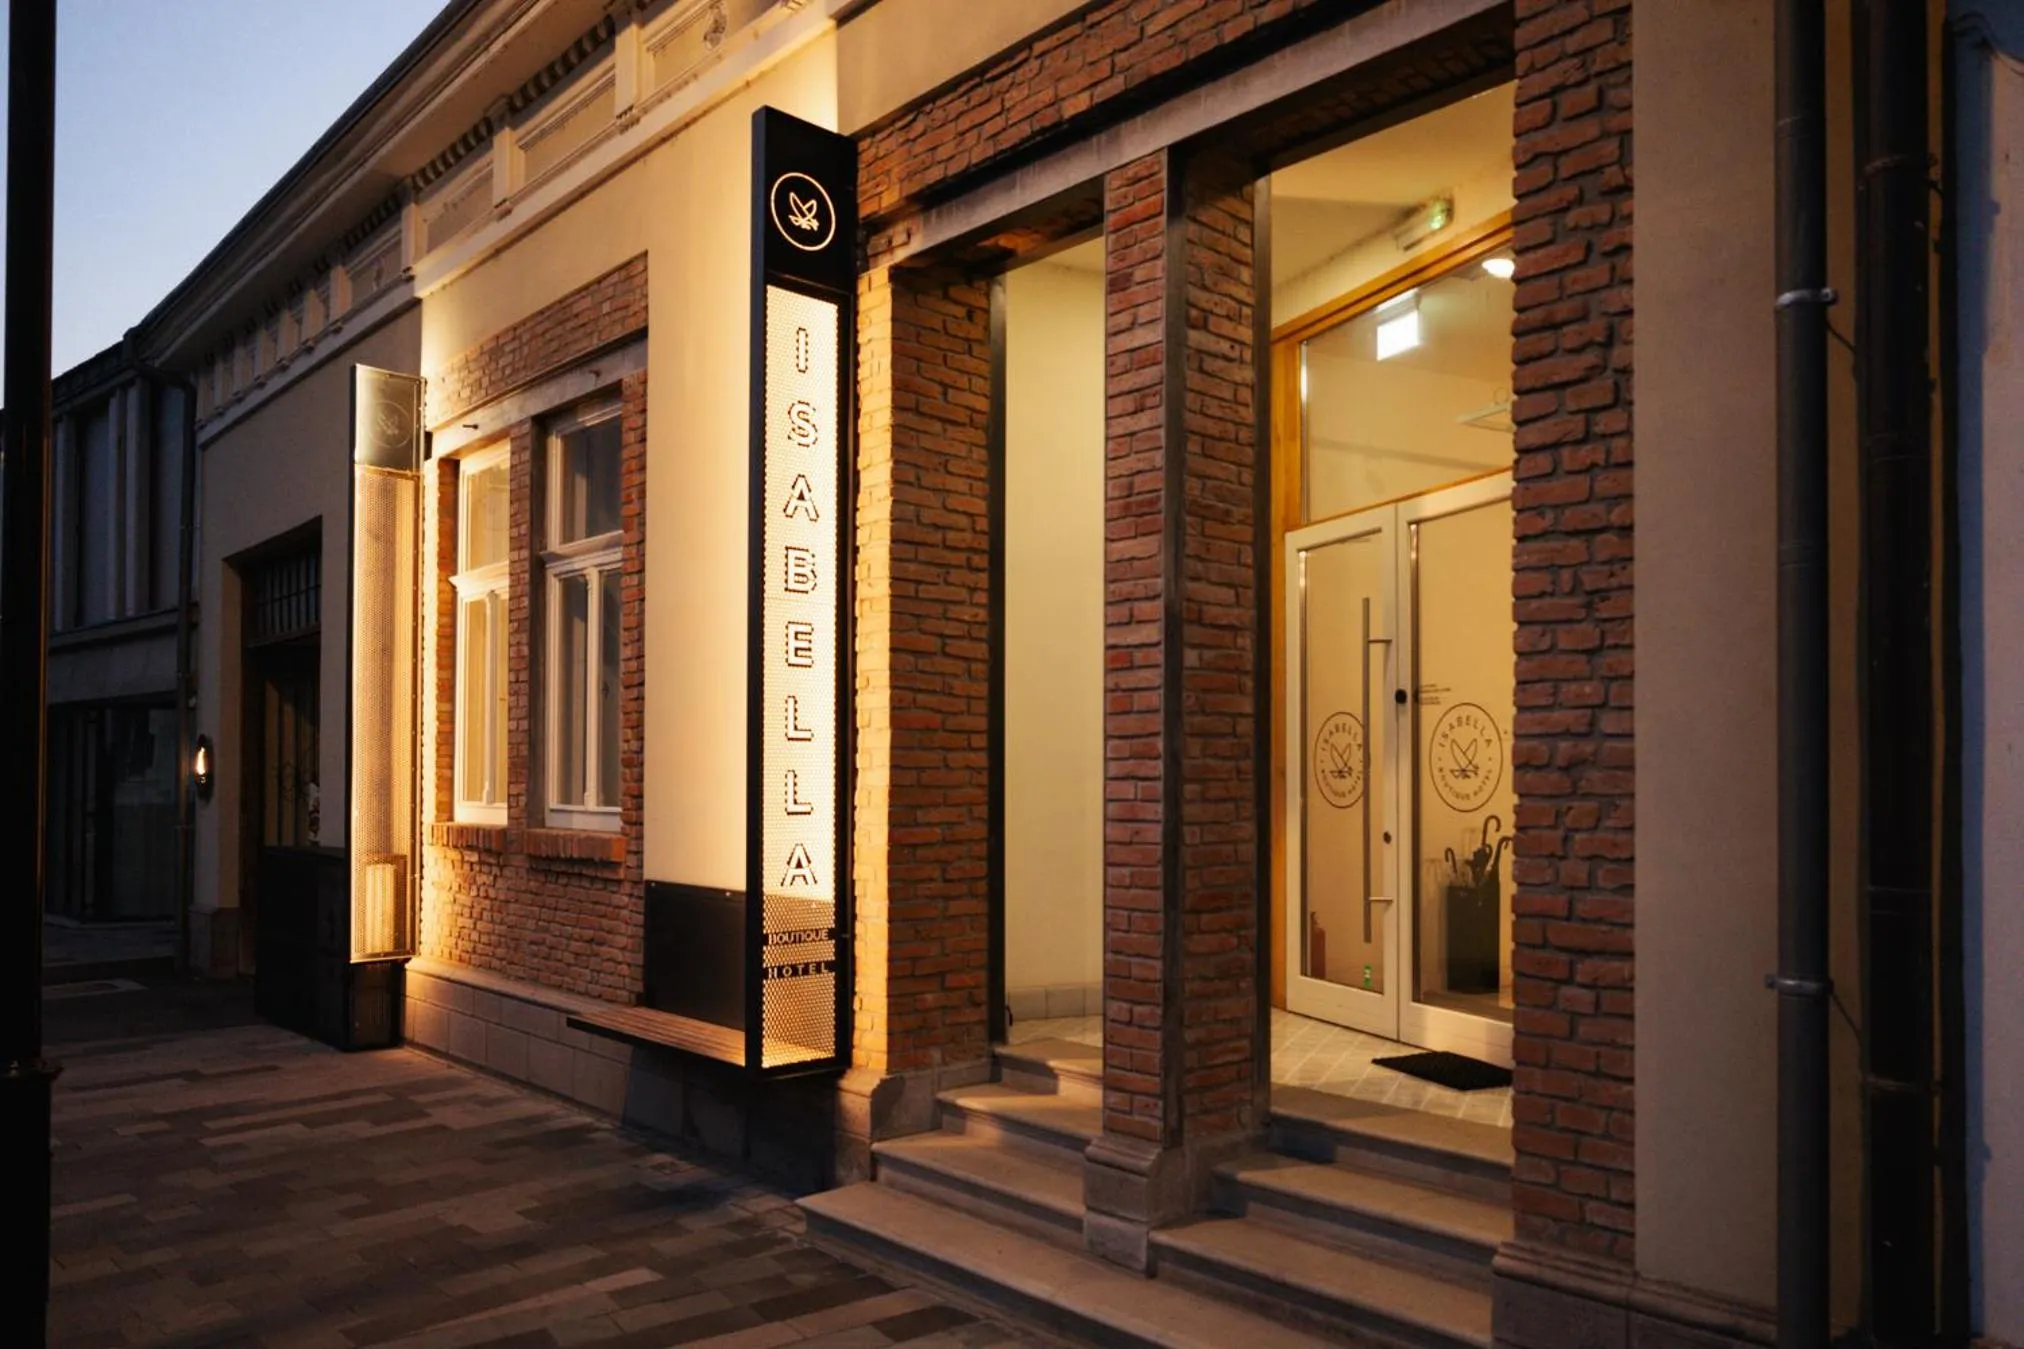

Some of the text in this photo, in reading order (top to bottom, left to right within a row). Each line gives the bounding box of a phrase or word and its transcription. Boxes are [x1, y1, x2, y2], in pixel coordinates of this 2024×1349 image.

[781, 327, 819, 887] ISABELLA
[1439, 714, 1493, 748] ISABELLA
[768, 929, 829, 945] BOUTIQUE
[768, 963, 829, 979] HOTEL
